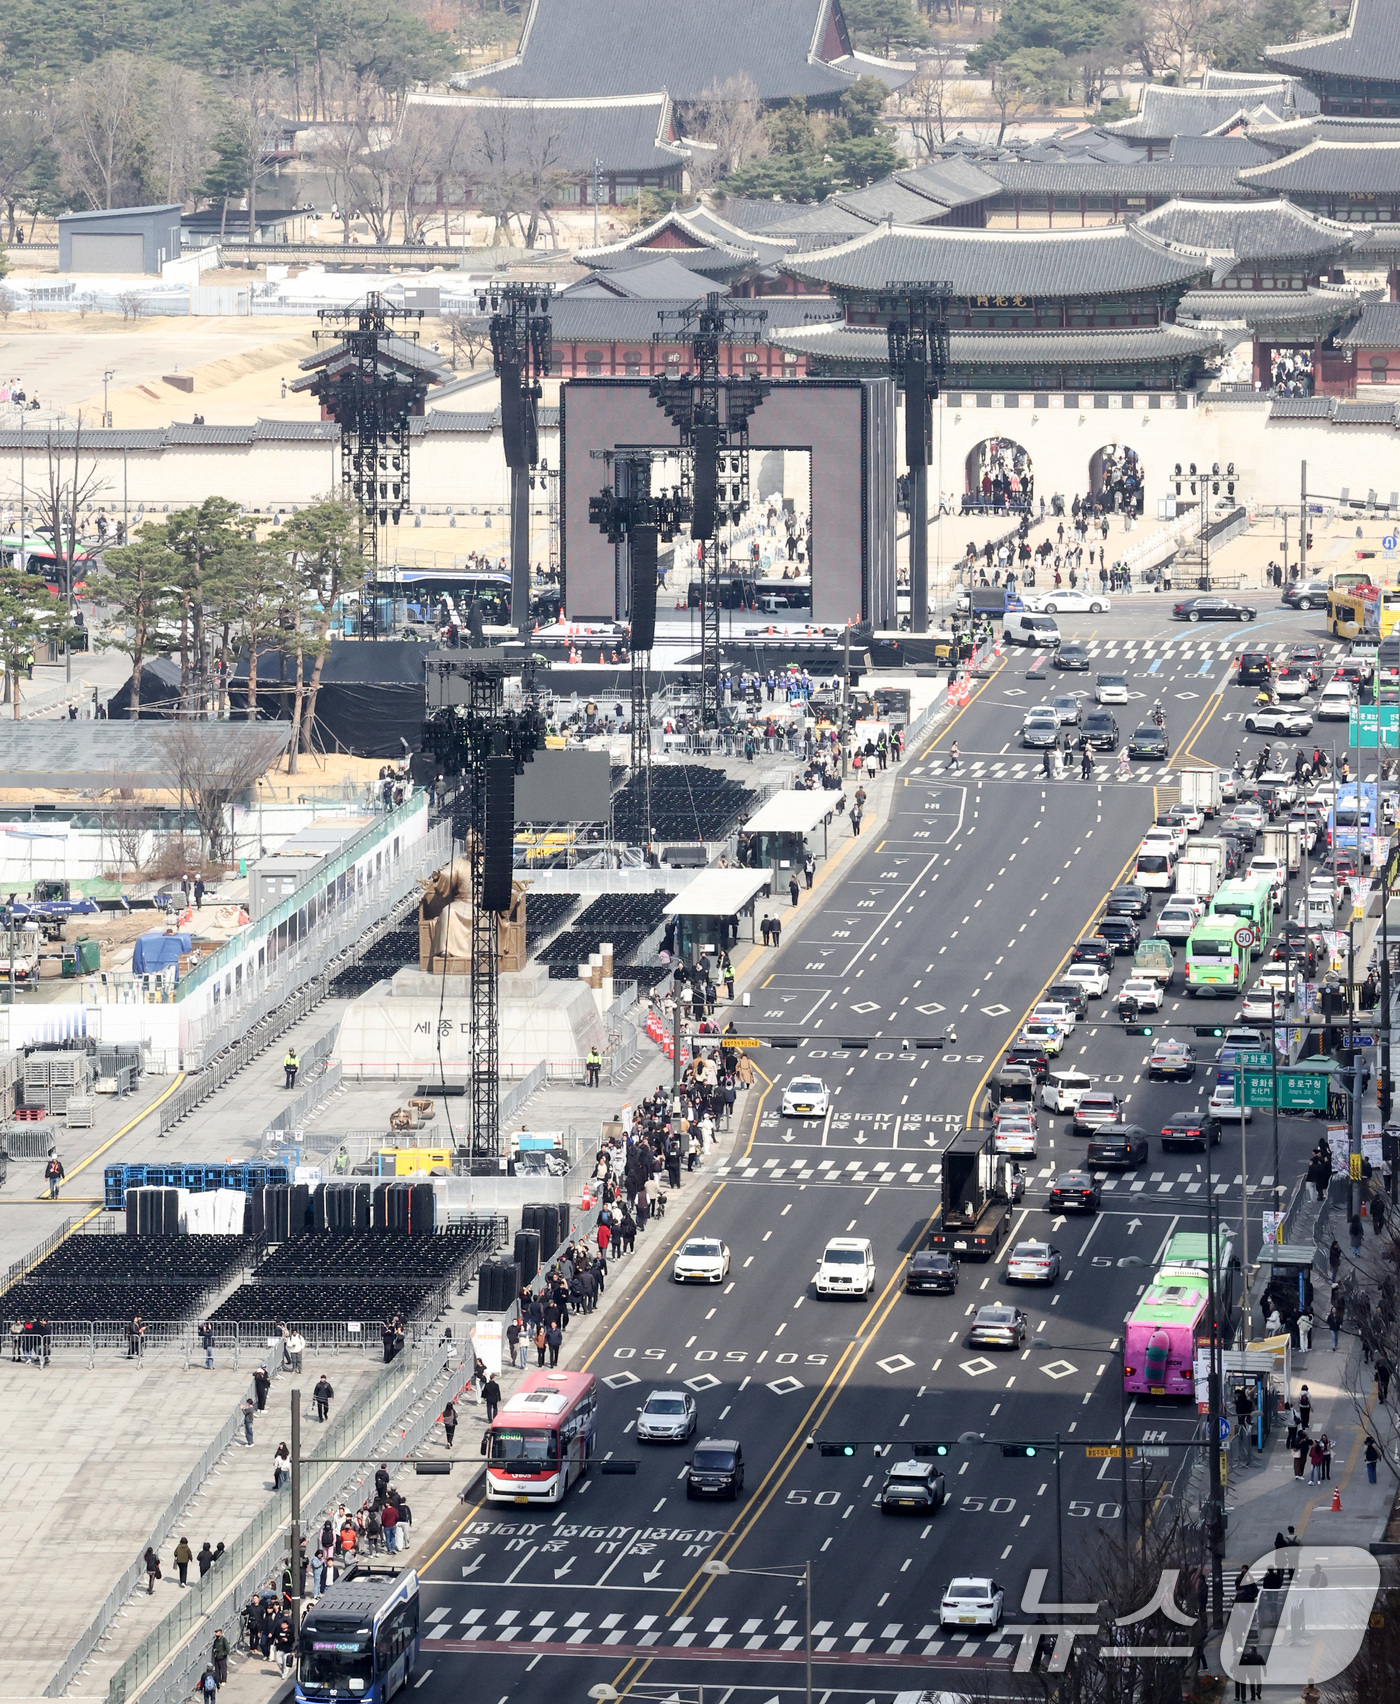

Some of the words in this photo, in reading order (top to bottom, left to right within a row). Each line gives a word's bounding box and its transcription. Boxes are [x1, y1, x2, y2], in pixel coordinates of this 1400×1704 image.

[1238, 933, 1251, 943] 50
[1287, 1078, 1321, 1089] 종로구청
[613, 1347, 667, 1360] 50
[693, 1350, 749, 1362] 50
[774, 1352, 830, 1365] 50
[784, 1488, 841, 1507] 50
[959, 1495, 1016, 1514] 50
[1067, 1500, 1122, 1519] 50
